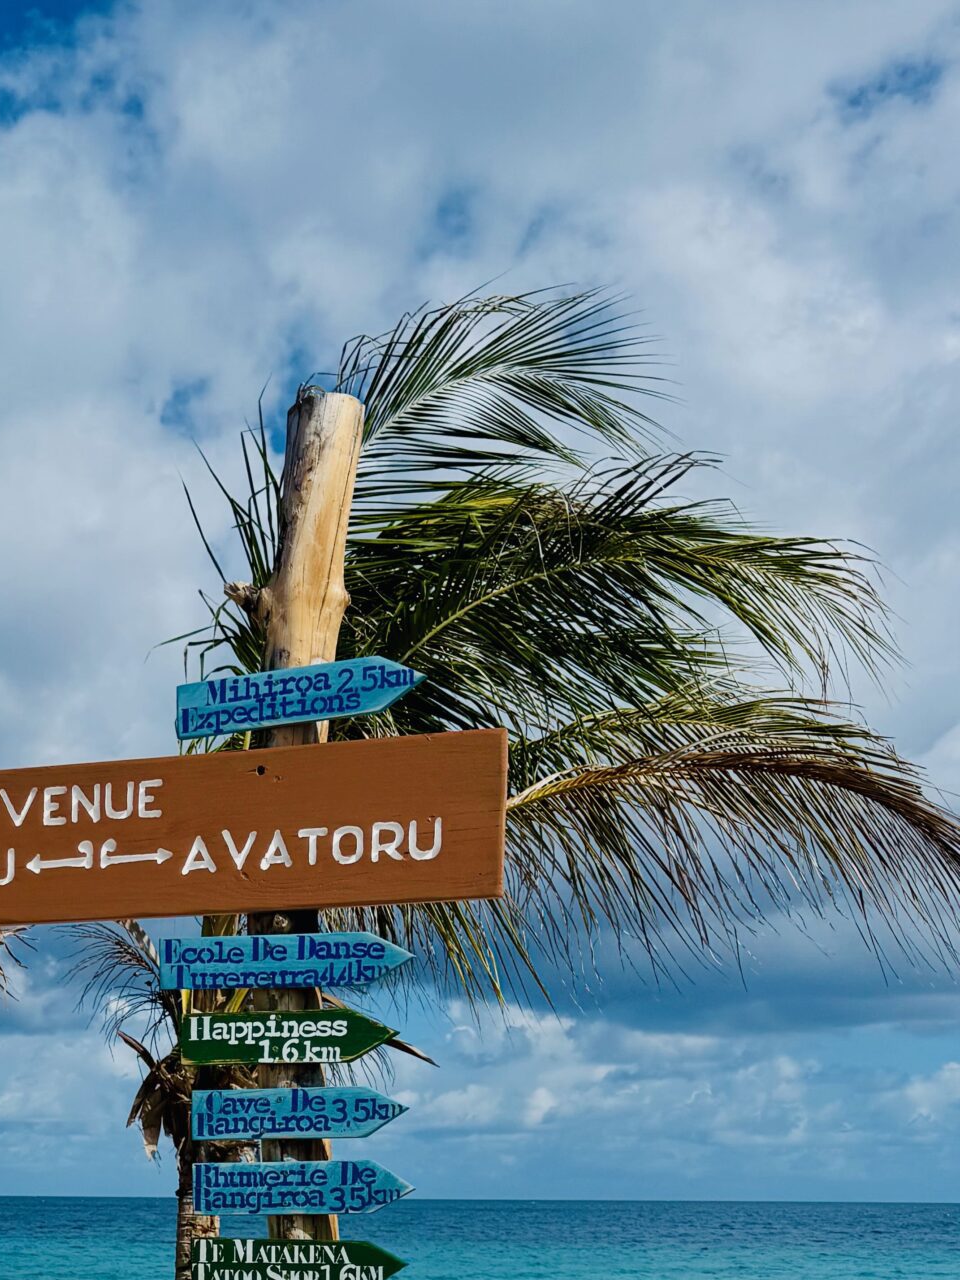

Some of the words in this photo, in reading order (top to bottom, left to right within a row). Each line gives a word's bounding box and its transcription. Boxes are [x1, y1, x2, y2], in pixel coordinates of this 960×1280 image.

[206, 672, 332, 706] Mihiroa
[181, 691, 361, 735] Expeditions
[181, 817, 442, 876] AVATORU
[164, 939, 244, 964] Ecole
[251, 937, 287, 961] De
[297, 935, 385, 960] Danse
[189, 1014, 347, 1044] Happiness
[206, 1091, 271, 1115] Cave
[290, 1089, 326, 1112] De
[196, 1111, 332, 1138] Rangiroa
[193, 1164, 328, 1188] Rhumerie
[341, 1161, 376, 1186] De
[193, 1187, 324, 1213] Rangiroa
[194, 1239, 224, 1263] TE
[233, 1239, 351, 1264] MATAKENA
